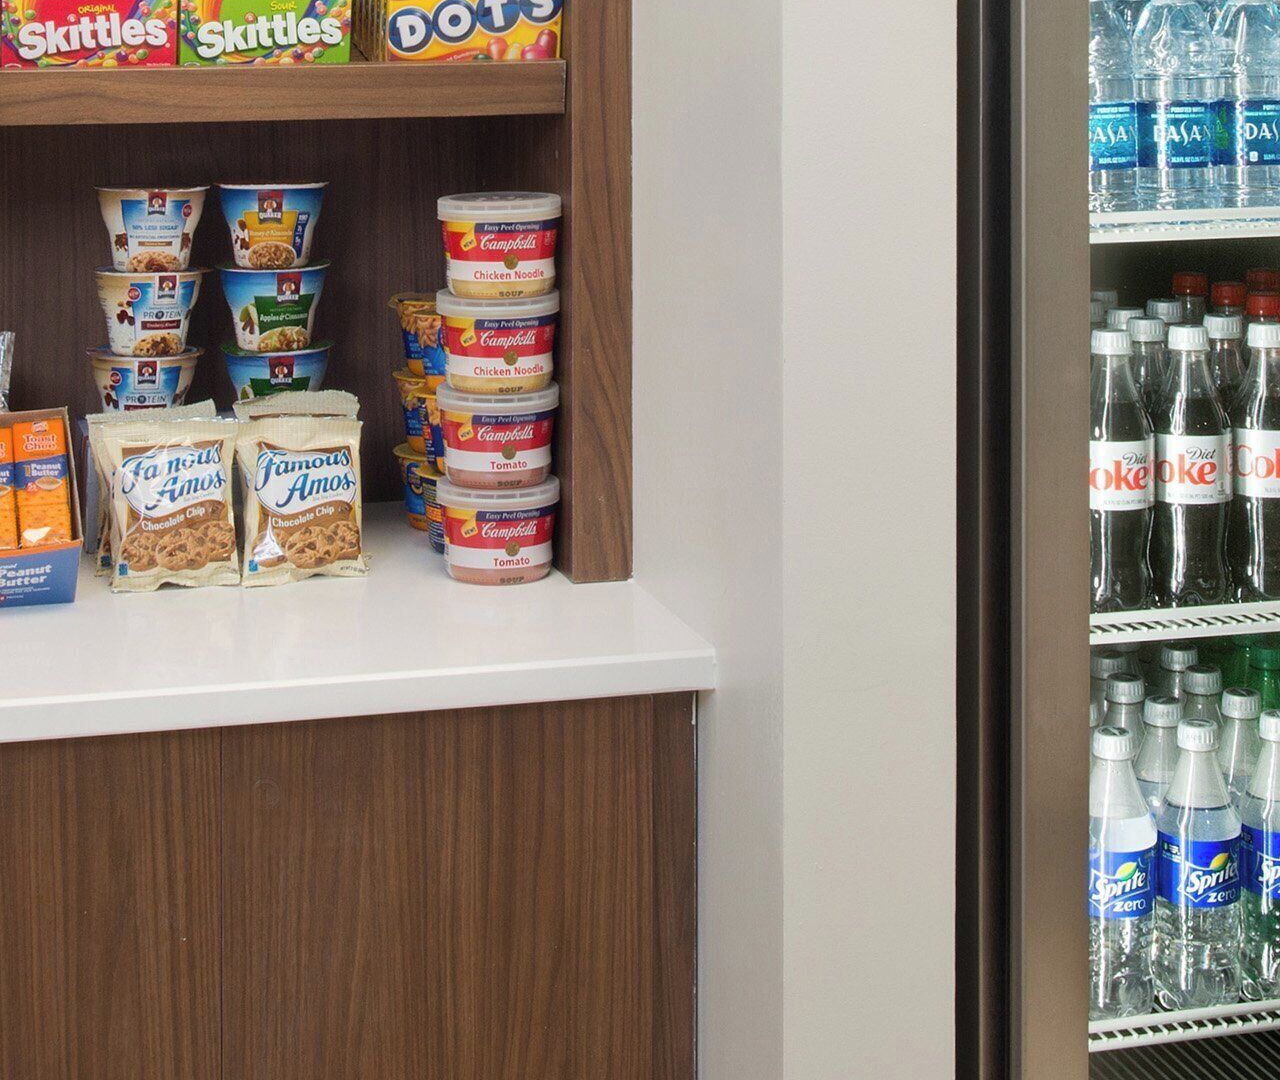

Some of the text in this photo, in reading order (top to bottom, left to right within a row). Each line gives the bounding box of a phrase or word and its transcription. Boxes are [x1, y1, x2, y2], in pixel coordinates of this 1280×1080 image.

[78, 4, 117, 14] ORIGINAL
[269, 0, 297, 11] SOUR
[18, 11, 169, 61] Skittles
[197, 11, 343, 59] Skittles
[480, 233, 537, 253] Campbell's
[473, 268, 545, 280] Chicken Noodle
[498, 290, 524, 298] SOUP
[480, 329, 536, 349] Campbell's
[473, 364, 544, 376] Chicken Noodle
[477, 424, 535, 443] Campbell's
[1186, 446, 1217, 463] Diet
[31, 462, 62, 471] Peanut
[31, 468, 60, 477] Butter
[255, 449, 350, 492] Famous
[490, 460, 529, 471] Tomato
[145, 470, 226, 511] Amos
[275, 472, 356, 508] Amos
[141, 505, 206, 532] Chocolate Chip
[272, 505, 335, 529] Chocolate Chip
[481, 521, 537, 540] Campbell's
[493, 557, 531, 568] Tomato
[1092, 873, 1147, 903] Sprite
[1113, 898, 1147, 913] zero
